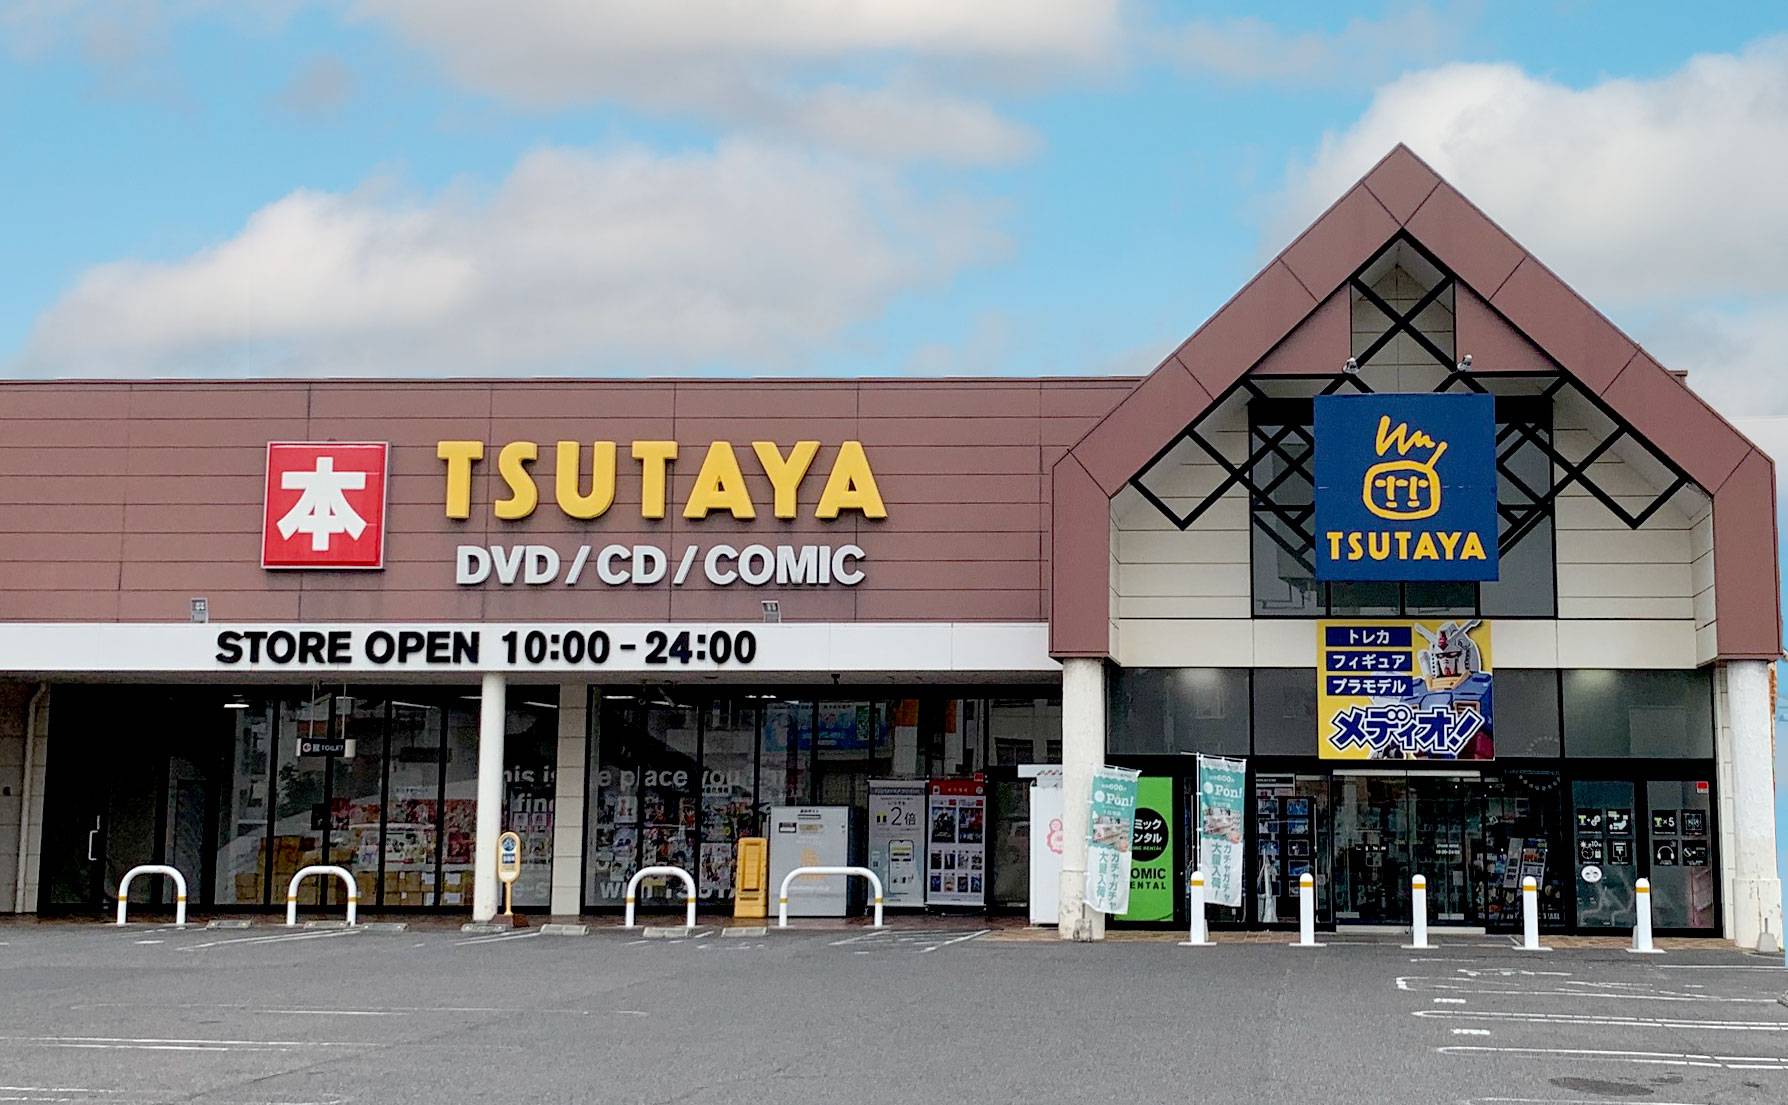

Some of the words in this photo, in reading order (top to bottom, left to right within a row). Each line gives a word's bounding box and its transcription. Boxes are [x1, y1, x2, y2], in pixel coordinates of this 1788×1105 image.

[437, 440, 888, 520] TSUTAYA
[276, 456, 367, 552] 本
[1327, 532, 1487, 560] TSUTAYA
[216, 631, 352, 664] STORE
[364, 631, 480, 664] OPEN
[1348, 630, 1390, 645] トレカ
[1332, 653, 1406, 669] フィギュア
[1332, 677, 1407, 694] プラモデル
[620, 766, 688, 792] place
[1133, 833, 1163, 843] ンタル
